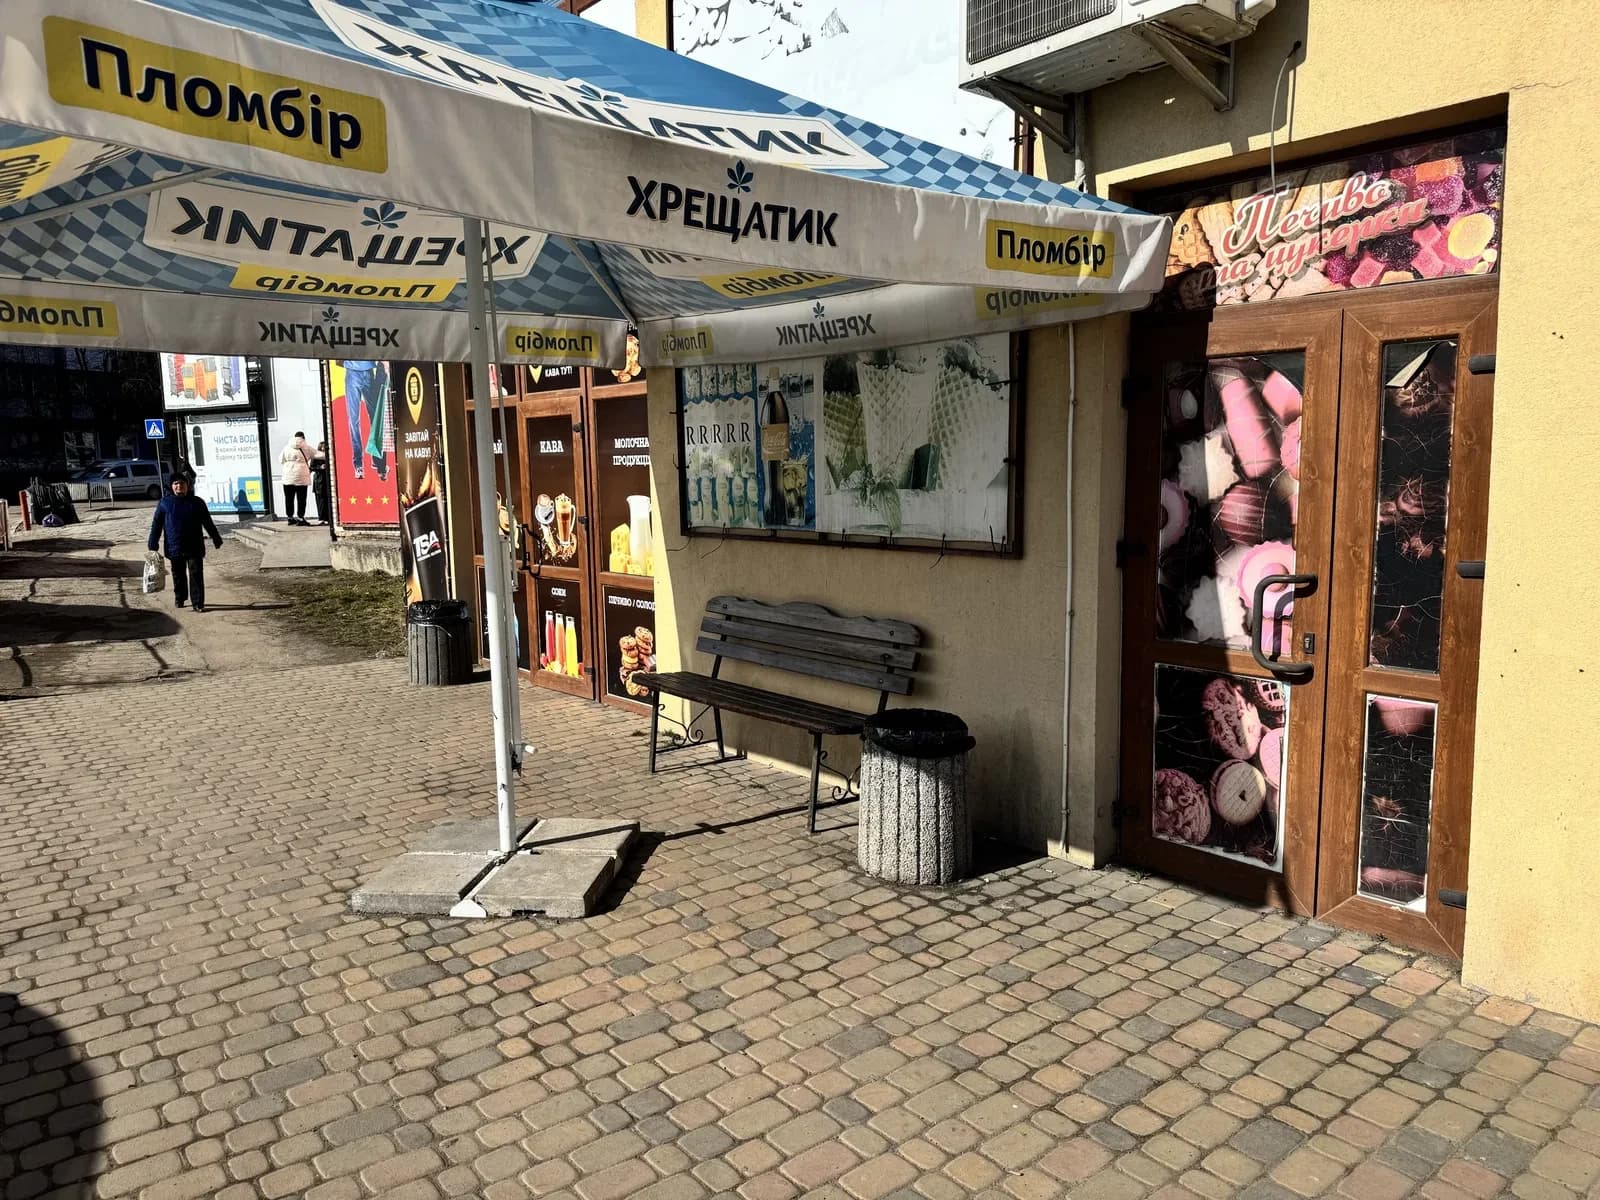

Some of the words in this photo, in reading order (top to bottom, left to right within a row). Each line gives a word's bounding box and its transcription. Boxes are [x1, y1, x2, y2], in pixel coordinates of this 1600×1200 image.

[80, 37, 362, 159] Пломбір
[626, 175, 839, 247] ХРЕЩАТИК
[1221, 171, 1391, 256] Печиво
[997, 229, 1106, 272] Пломбір
[1201, 254, 1260, 290] та
[1264, 198, 1428, 277] цукерки
[545, 368, 560, 377] КАВА
[213, 435, 238, 445] ЧИСТА
[239, 434, 257, 445] ВОД
[404, 429, 429, 443] ЗАВІТАЙ
[614, 437, 649, 449] МОЛОЧНА
[404, 447, 413, 458] НА
[493, 439, 503, 454] АЙ
[540, 440, 564, 453] КАВА
[613, 454, 650, 467] ПРОДУКЦІ
